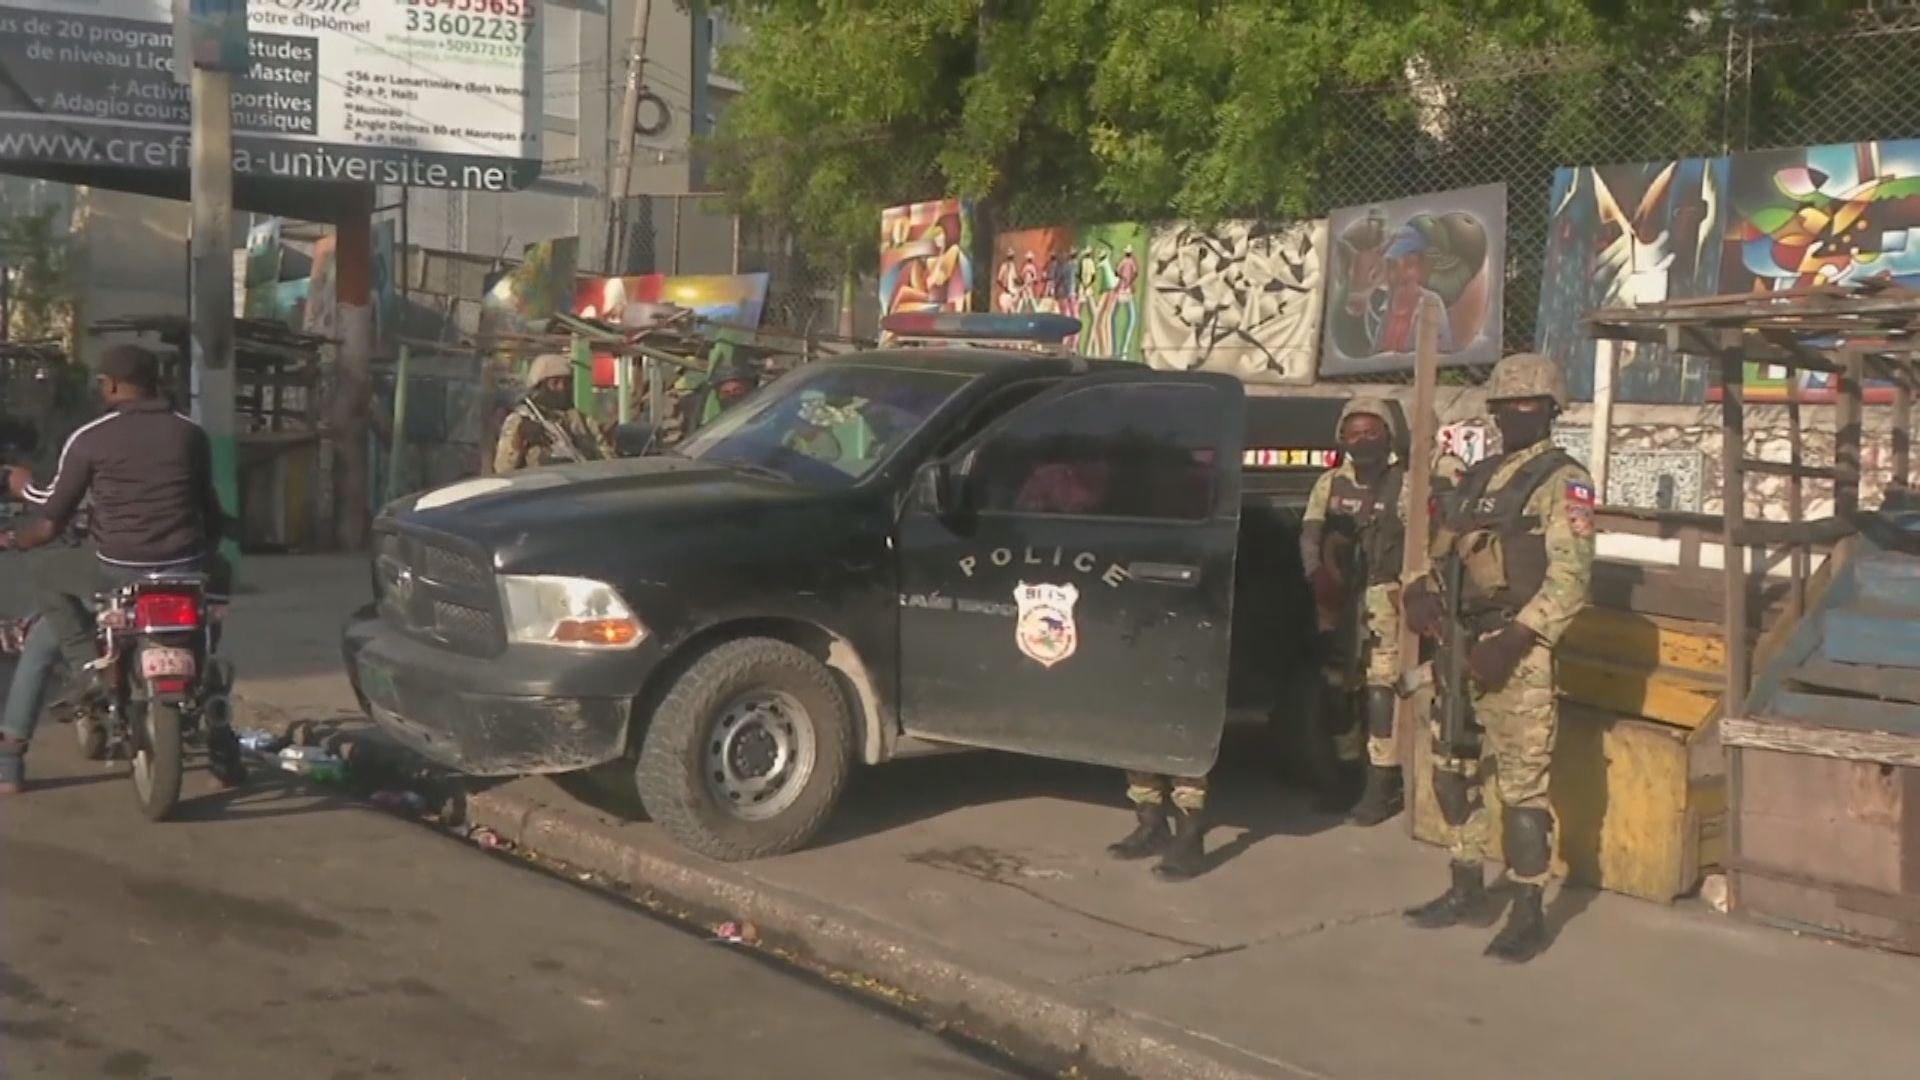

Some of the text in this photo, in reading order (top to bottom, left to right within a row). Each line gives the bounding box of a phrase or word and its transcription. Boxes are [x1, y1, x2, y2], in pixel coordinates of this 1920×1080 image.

[23, 17, 51, 36] de
[57, 20, 84, 38] 20
[247, 11, 370, 33] otre diplôme!
[406, 9, 536, 43] 33602237
[26, 41, 53, 60] de
[59, 45, 130, 67] niveau
[53, 93, 129, 116] Adagio
[134, 101, 190, 120] cours
[232, 92, 313, 113] portives
[958, 546, 1131, 588] POLICE
